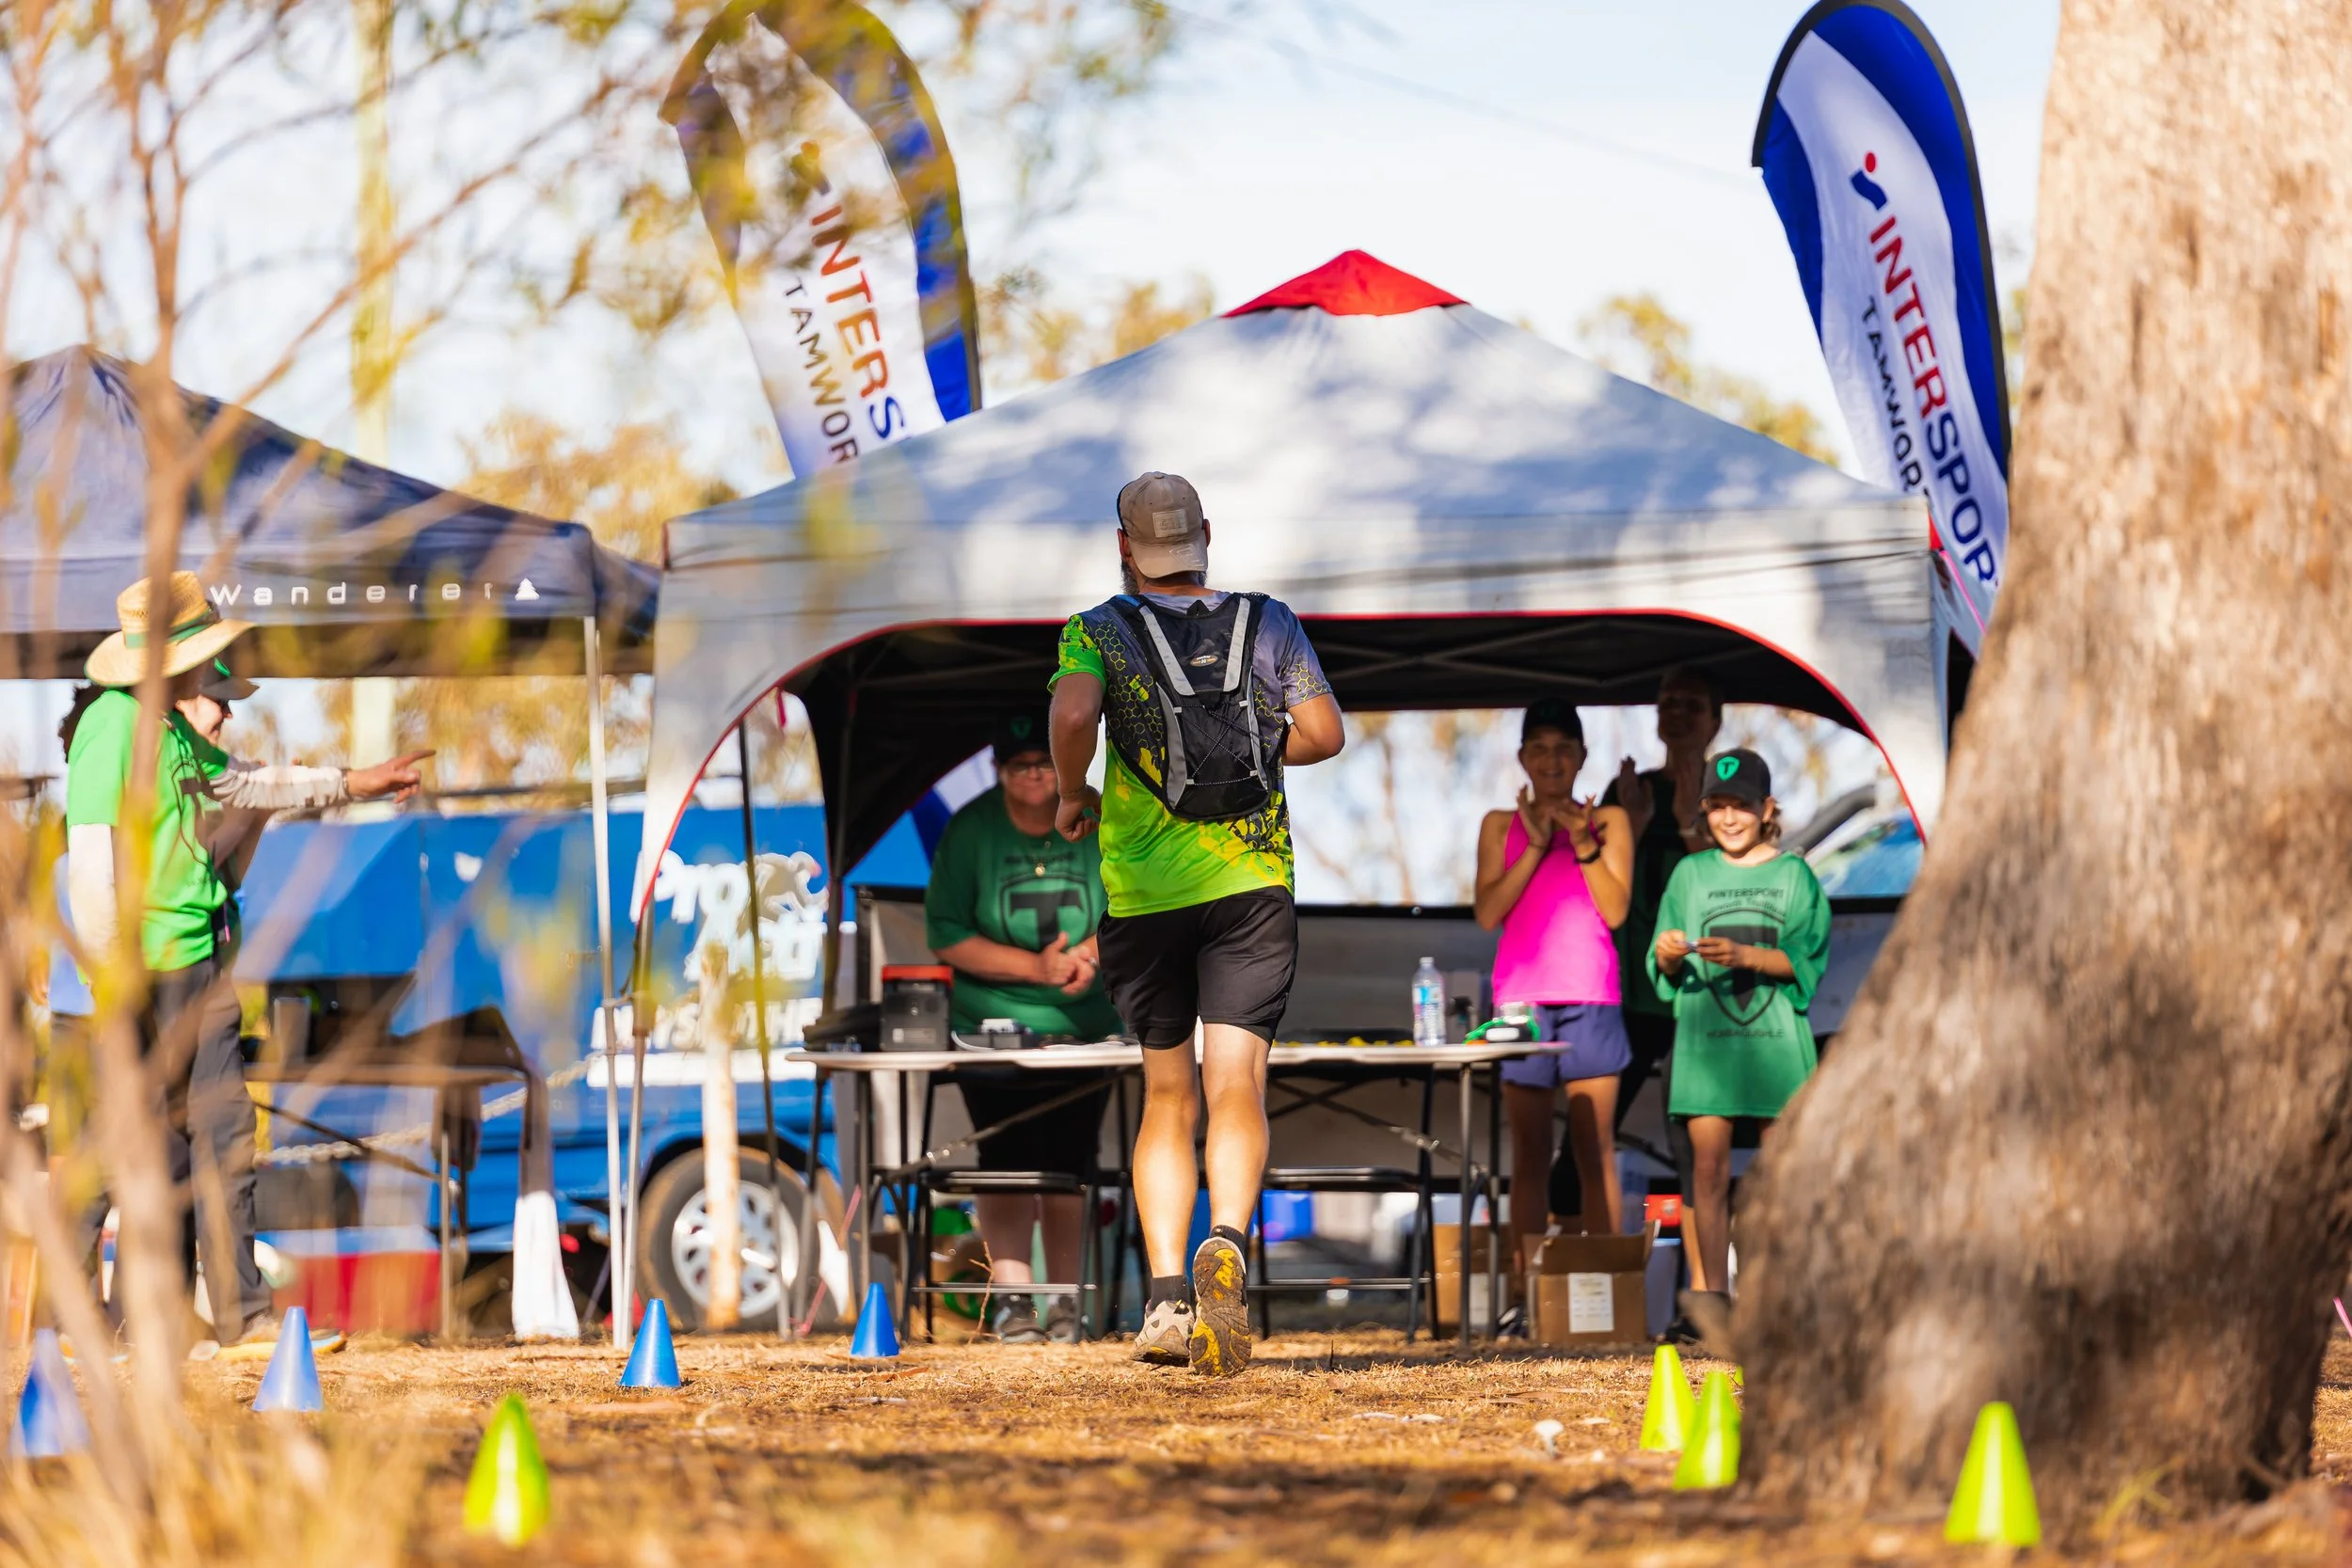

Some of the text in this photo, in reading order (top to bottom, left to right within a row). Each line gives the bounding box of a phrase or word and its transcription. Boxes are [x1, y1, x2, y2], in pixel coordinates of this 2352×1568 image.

[811, 205, 910, 440] INTERS
[1861, 294, 1930, 497] TAMWOR
[1869, 216, 1998, 588] INTERSPOR
